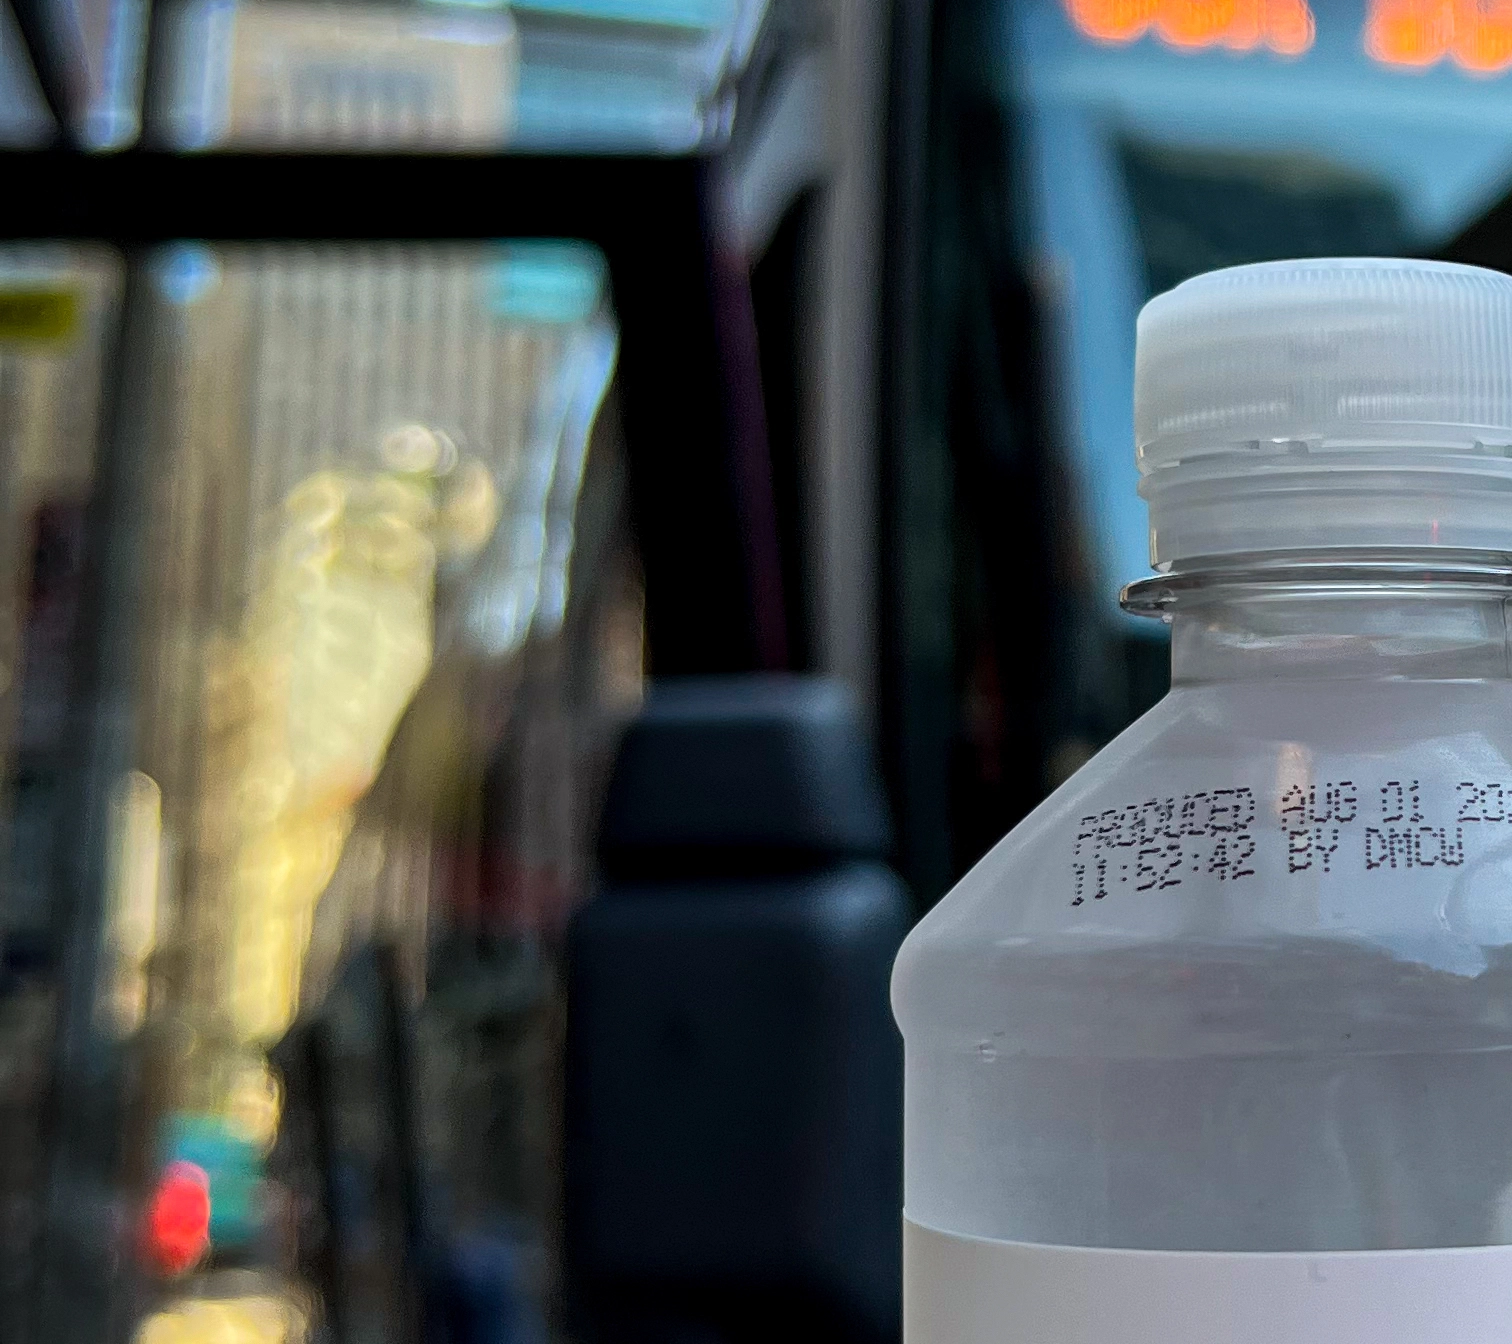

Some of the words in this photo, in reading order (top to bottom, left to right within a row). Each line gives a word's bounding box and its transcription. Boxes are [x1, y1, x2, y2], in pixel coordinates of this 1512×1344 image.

[1281, 781, 1356, 831] AUG
[1380, 779, 1424, 823] 01
[1288, 828, 1340, 873] BY
